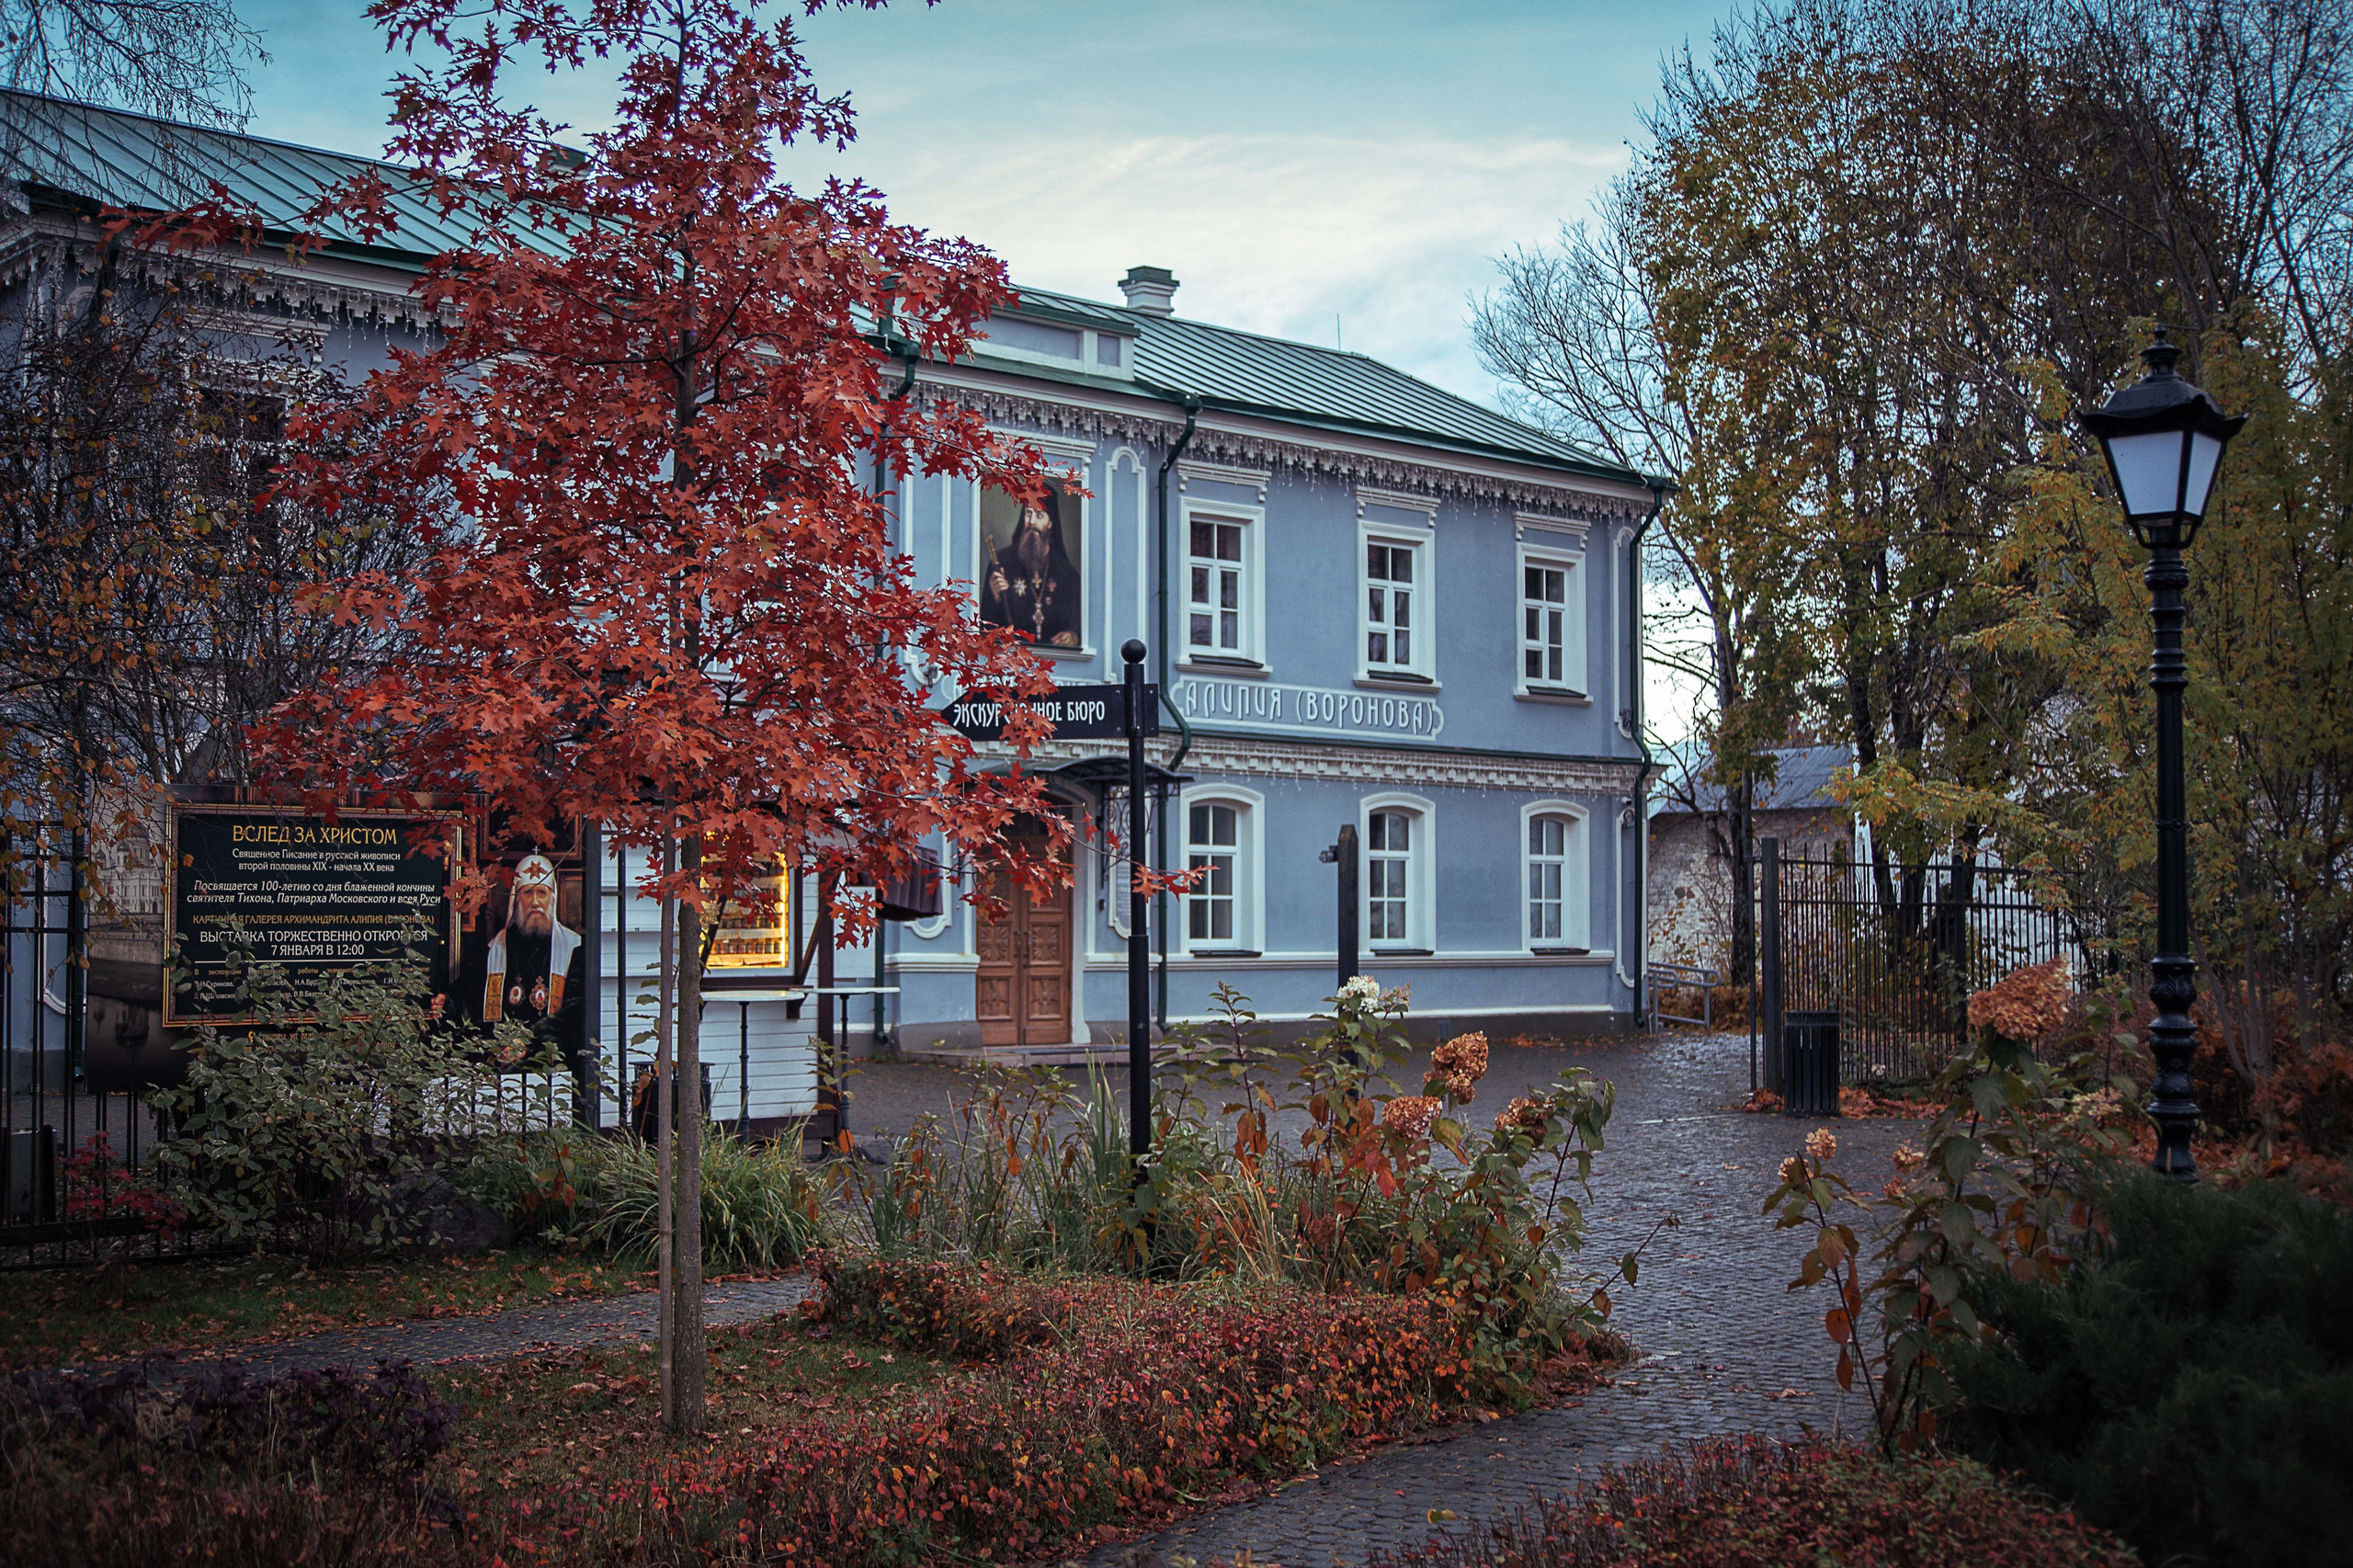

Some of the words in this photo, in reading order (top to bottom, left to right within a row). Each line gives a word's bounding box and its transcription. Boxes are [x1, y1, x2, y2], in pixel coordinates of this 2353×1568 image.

[953, 701, 1063, 727] ЭКСКУРННОЕ
[1067, 700, 1105, 725] БЮРО
[1186, 681, 1281, 721] АЛИПИЯ
[1296, 690, 1434, 736] (ВОРОНОВА)
[233, 825, 290, 846] ВСЛЕД
[294, 826, 315, 843] ЗА
[319, 827, 397, 845] ХРИСТОМ
[233, 847, 280, 858] Священное
[282, 849, 318, 859] Писание
[325, 851, 358, 862] русской
[239, 862, 268, 872] второй
[269, 863, 311, 871] половины
[194, 880, 257, 892] Посвящается
[261, 881, 311, 891] 100-летию
[313, 883, 324, 892] со
[325, 883, 342, 892] дня
[344, 881, 394, 892] блаженной
[396, 884, 435, 892] кончины
[187, 894, 234, 903] святителя
[237, 892, 275, 904] Тихона,
[277, 892, 327, 905] Патриарха
[329, 893, 388, 903] Московского
[397, 895, 417, 903] всея
[419, 893, 441, 905] Руси
[244, 915, 282, 924] ГАЛЕРЕЯ
[283, 915, 349, 925] АРХИМАНДРИТА
[350, 915, 383, 924] АЛИПИЯ
[384, 915, 435, 926] (ВОНВА)
[267, 930, 361, 942] ТОРЖЕСТВЕННО
[363, 930, 427, 941] ОТКРОСЯ
[270, 945, 278, 956] 7
[279, 945, 324, 956] ЯНВАРЯ
[325, 944, 334, 955] В
[336, 944, 365, 955] 12:00
